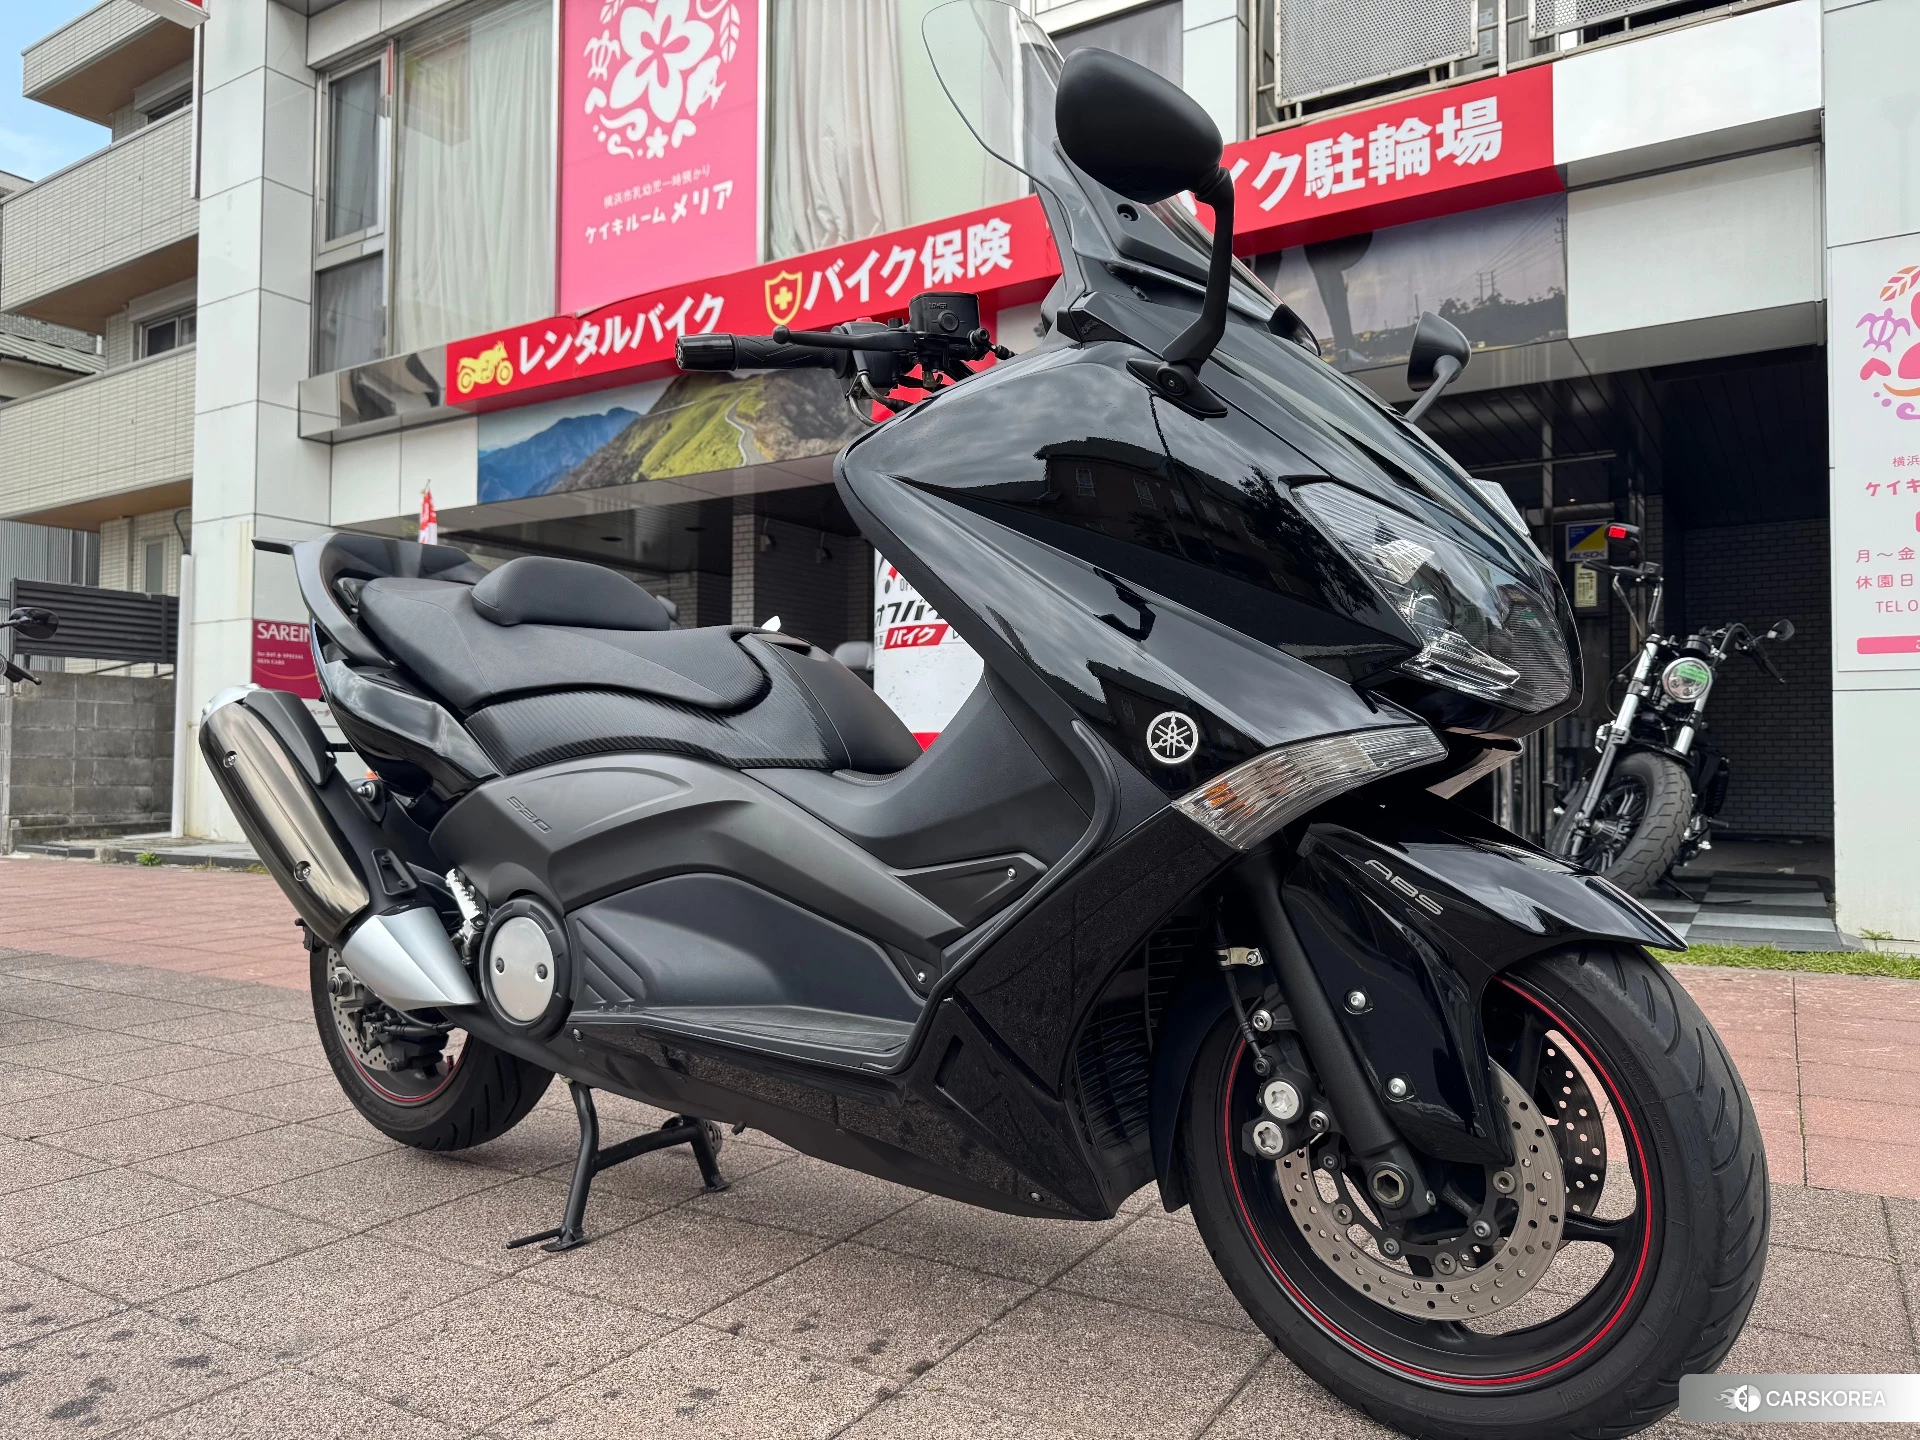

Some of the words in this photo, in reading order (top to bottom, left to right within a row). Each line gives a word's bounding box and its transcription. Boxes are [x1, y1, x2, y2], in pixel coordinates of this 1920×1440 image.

[1176, 97, 1502, 215] ク駐輪場
[585, 206, 667, 244] ケイキルーム
[671, 180, 733, 223] メリア
[803, 217, 1013, 311] バイク保険
[519, 292, 725, 375] レンタルバイク
[1865, 478, 1920, 497] ケイキ
[1856, 573, 1914, 590] 休園日
[1875, 600, 1904, 613] TEL
[889, 626, 937, 646] バイク
[506, 795, 552, 834] 530
[1364, 859, 1444, 915] ABS
